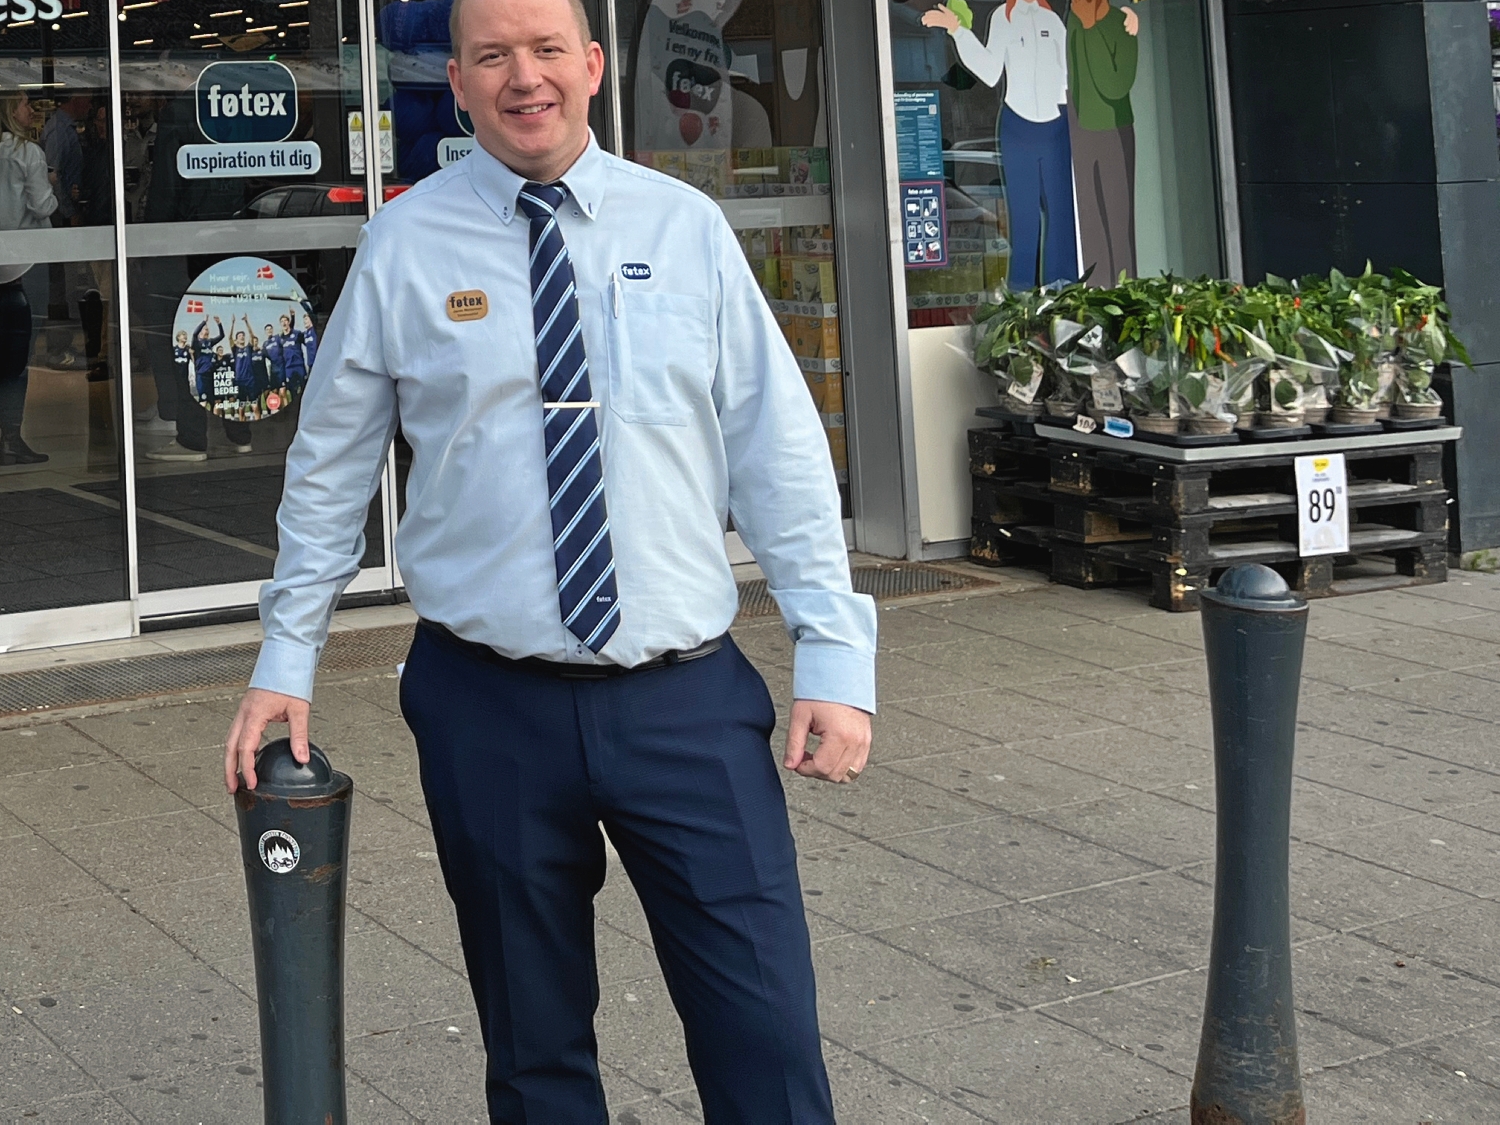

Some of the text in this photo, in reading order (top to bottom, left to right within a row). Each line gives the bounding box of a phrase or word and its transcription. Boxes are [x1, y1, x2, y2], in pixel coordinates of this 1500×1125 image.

[207, 82, 288, 118] føtex
[186, 149, 313, 173] Inspiration til dig
[213, 370, 236, 380] HVER
[213, 378, 233, 388] DAG
[214, 386, 239, 396] BEDRE
[1309, 488, 1336, 523] 89
